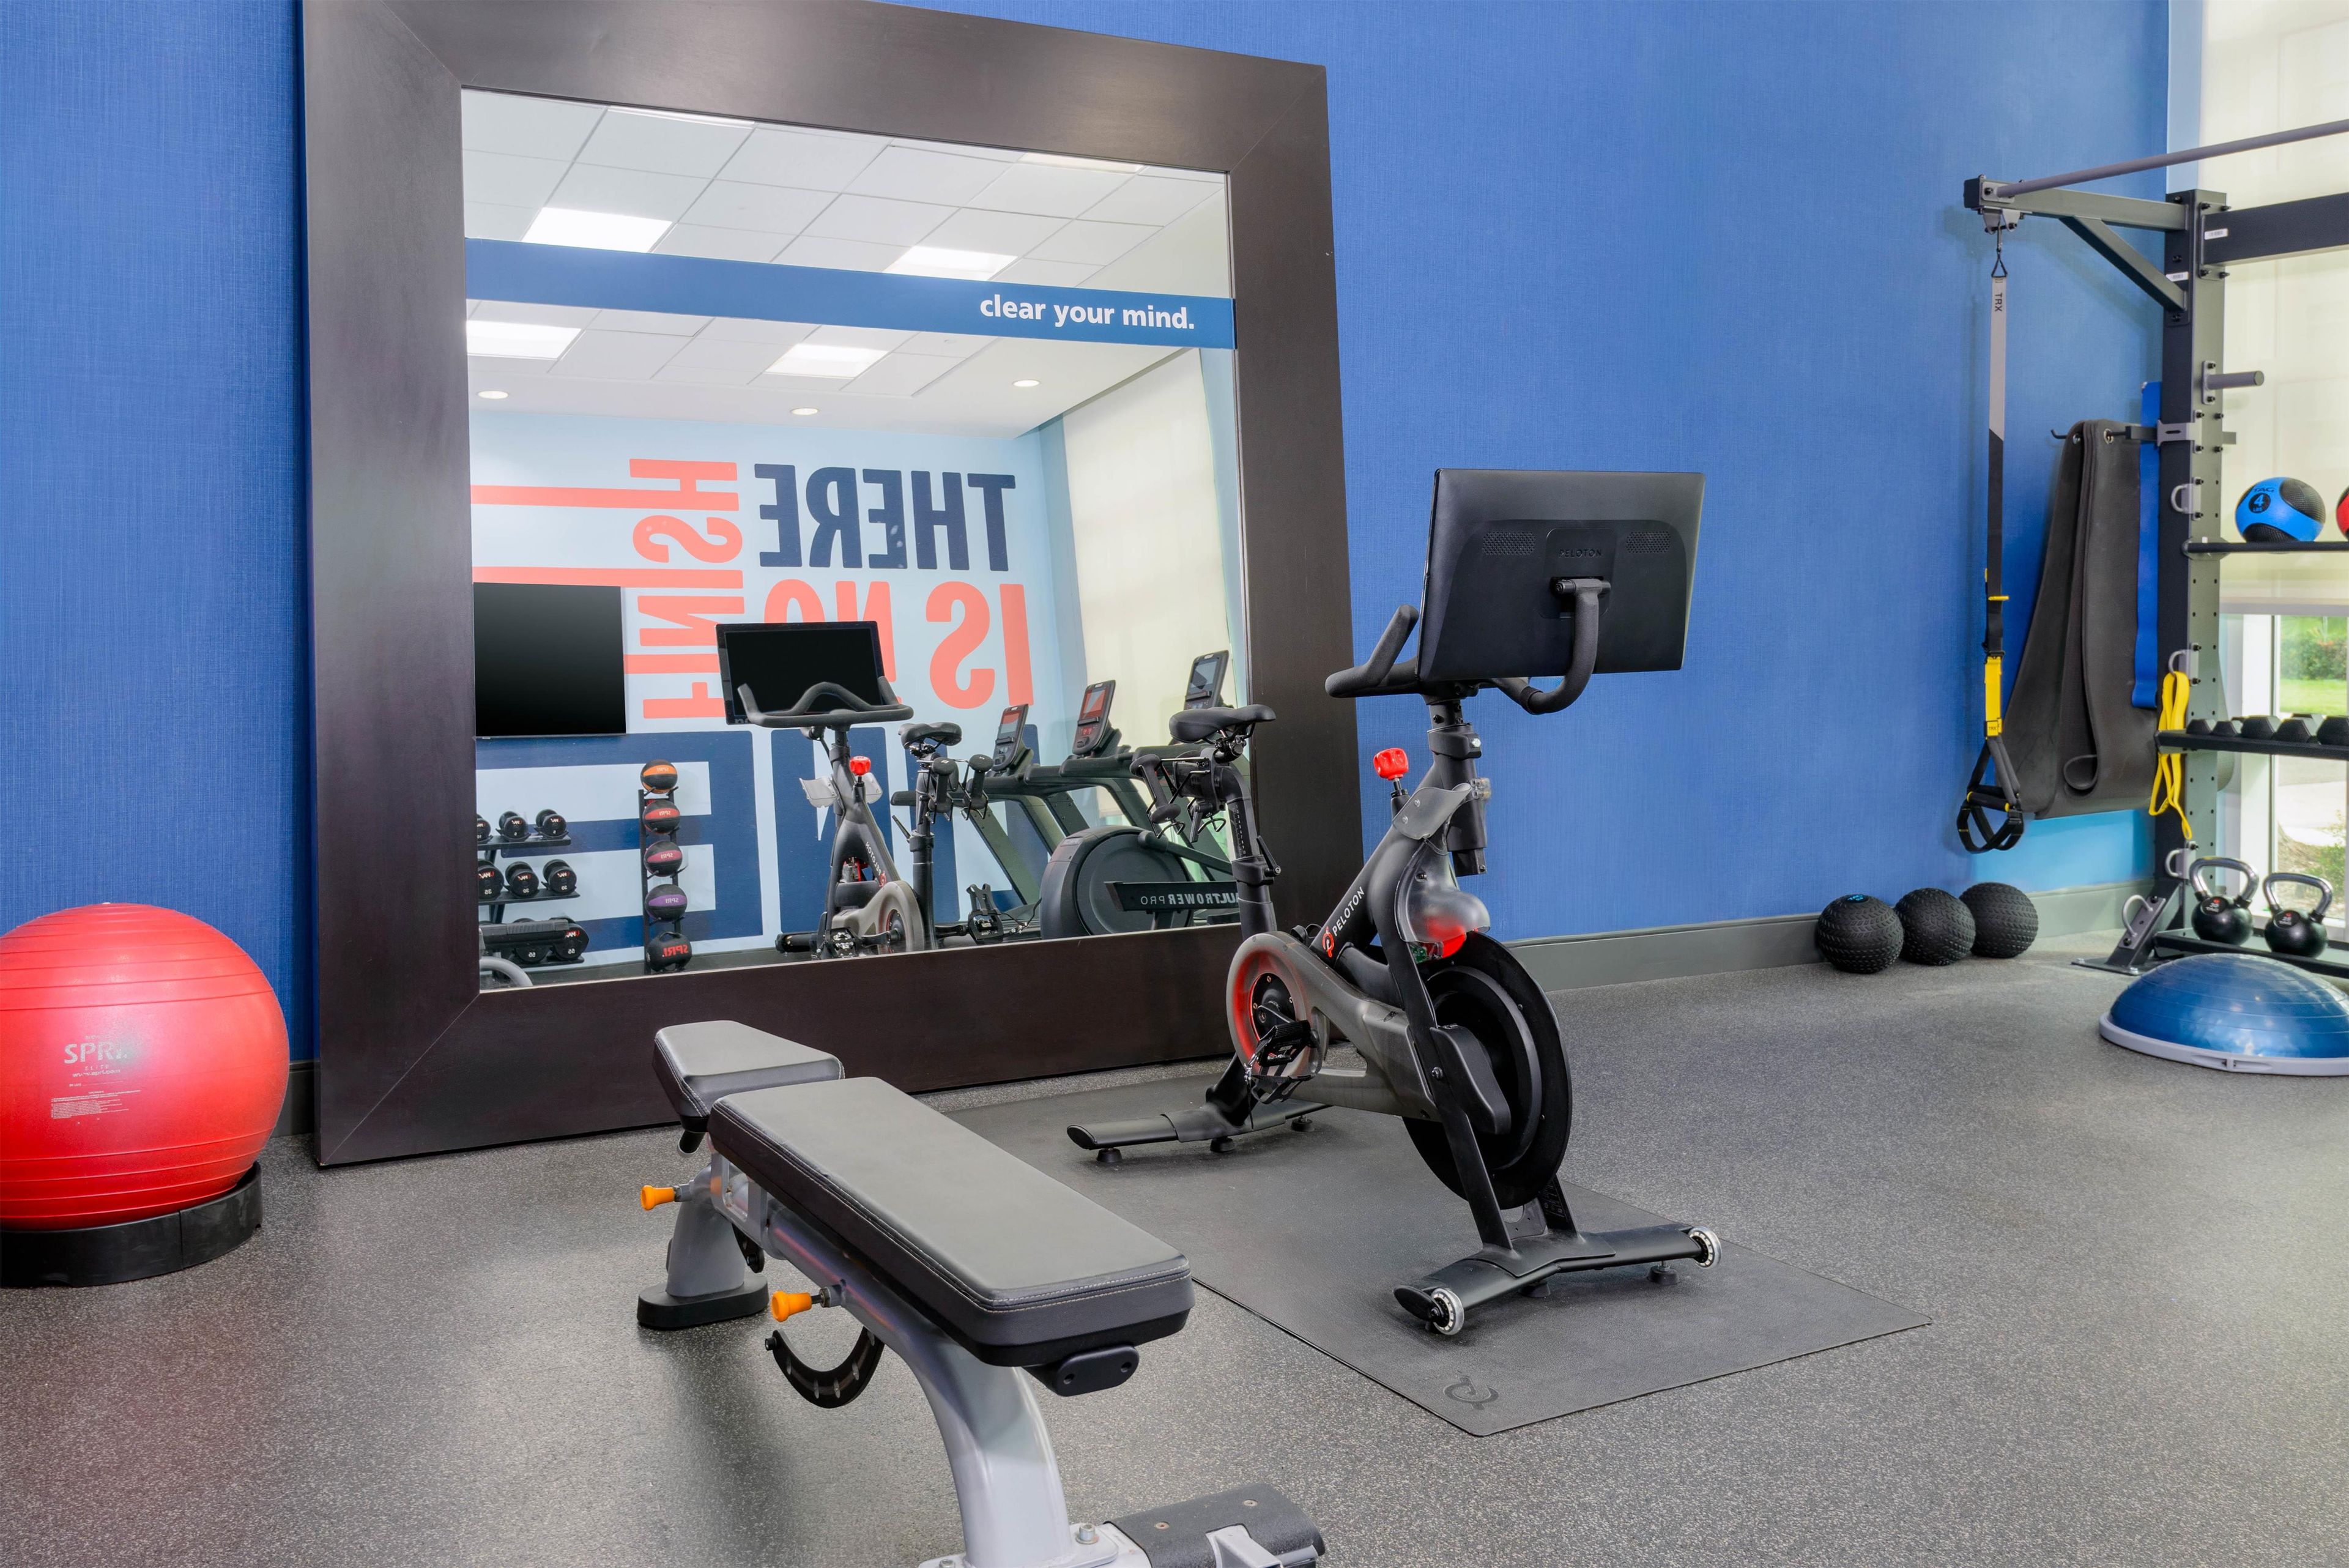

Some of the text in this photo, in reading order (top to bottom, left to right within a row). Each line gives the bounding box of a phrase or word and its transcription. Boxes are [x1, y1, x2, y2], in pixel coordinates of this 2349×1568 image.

[980, 294, 1195, 330] clear your mind.
[1994, 292, 2003, 312] TRX
[2254, 494, 2264, 507] 4
[1558, 548, 1603, 558] PELOTON
[1332, 886, 1365, 937] PELOTON
